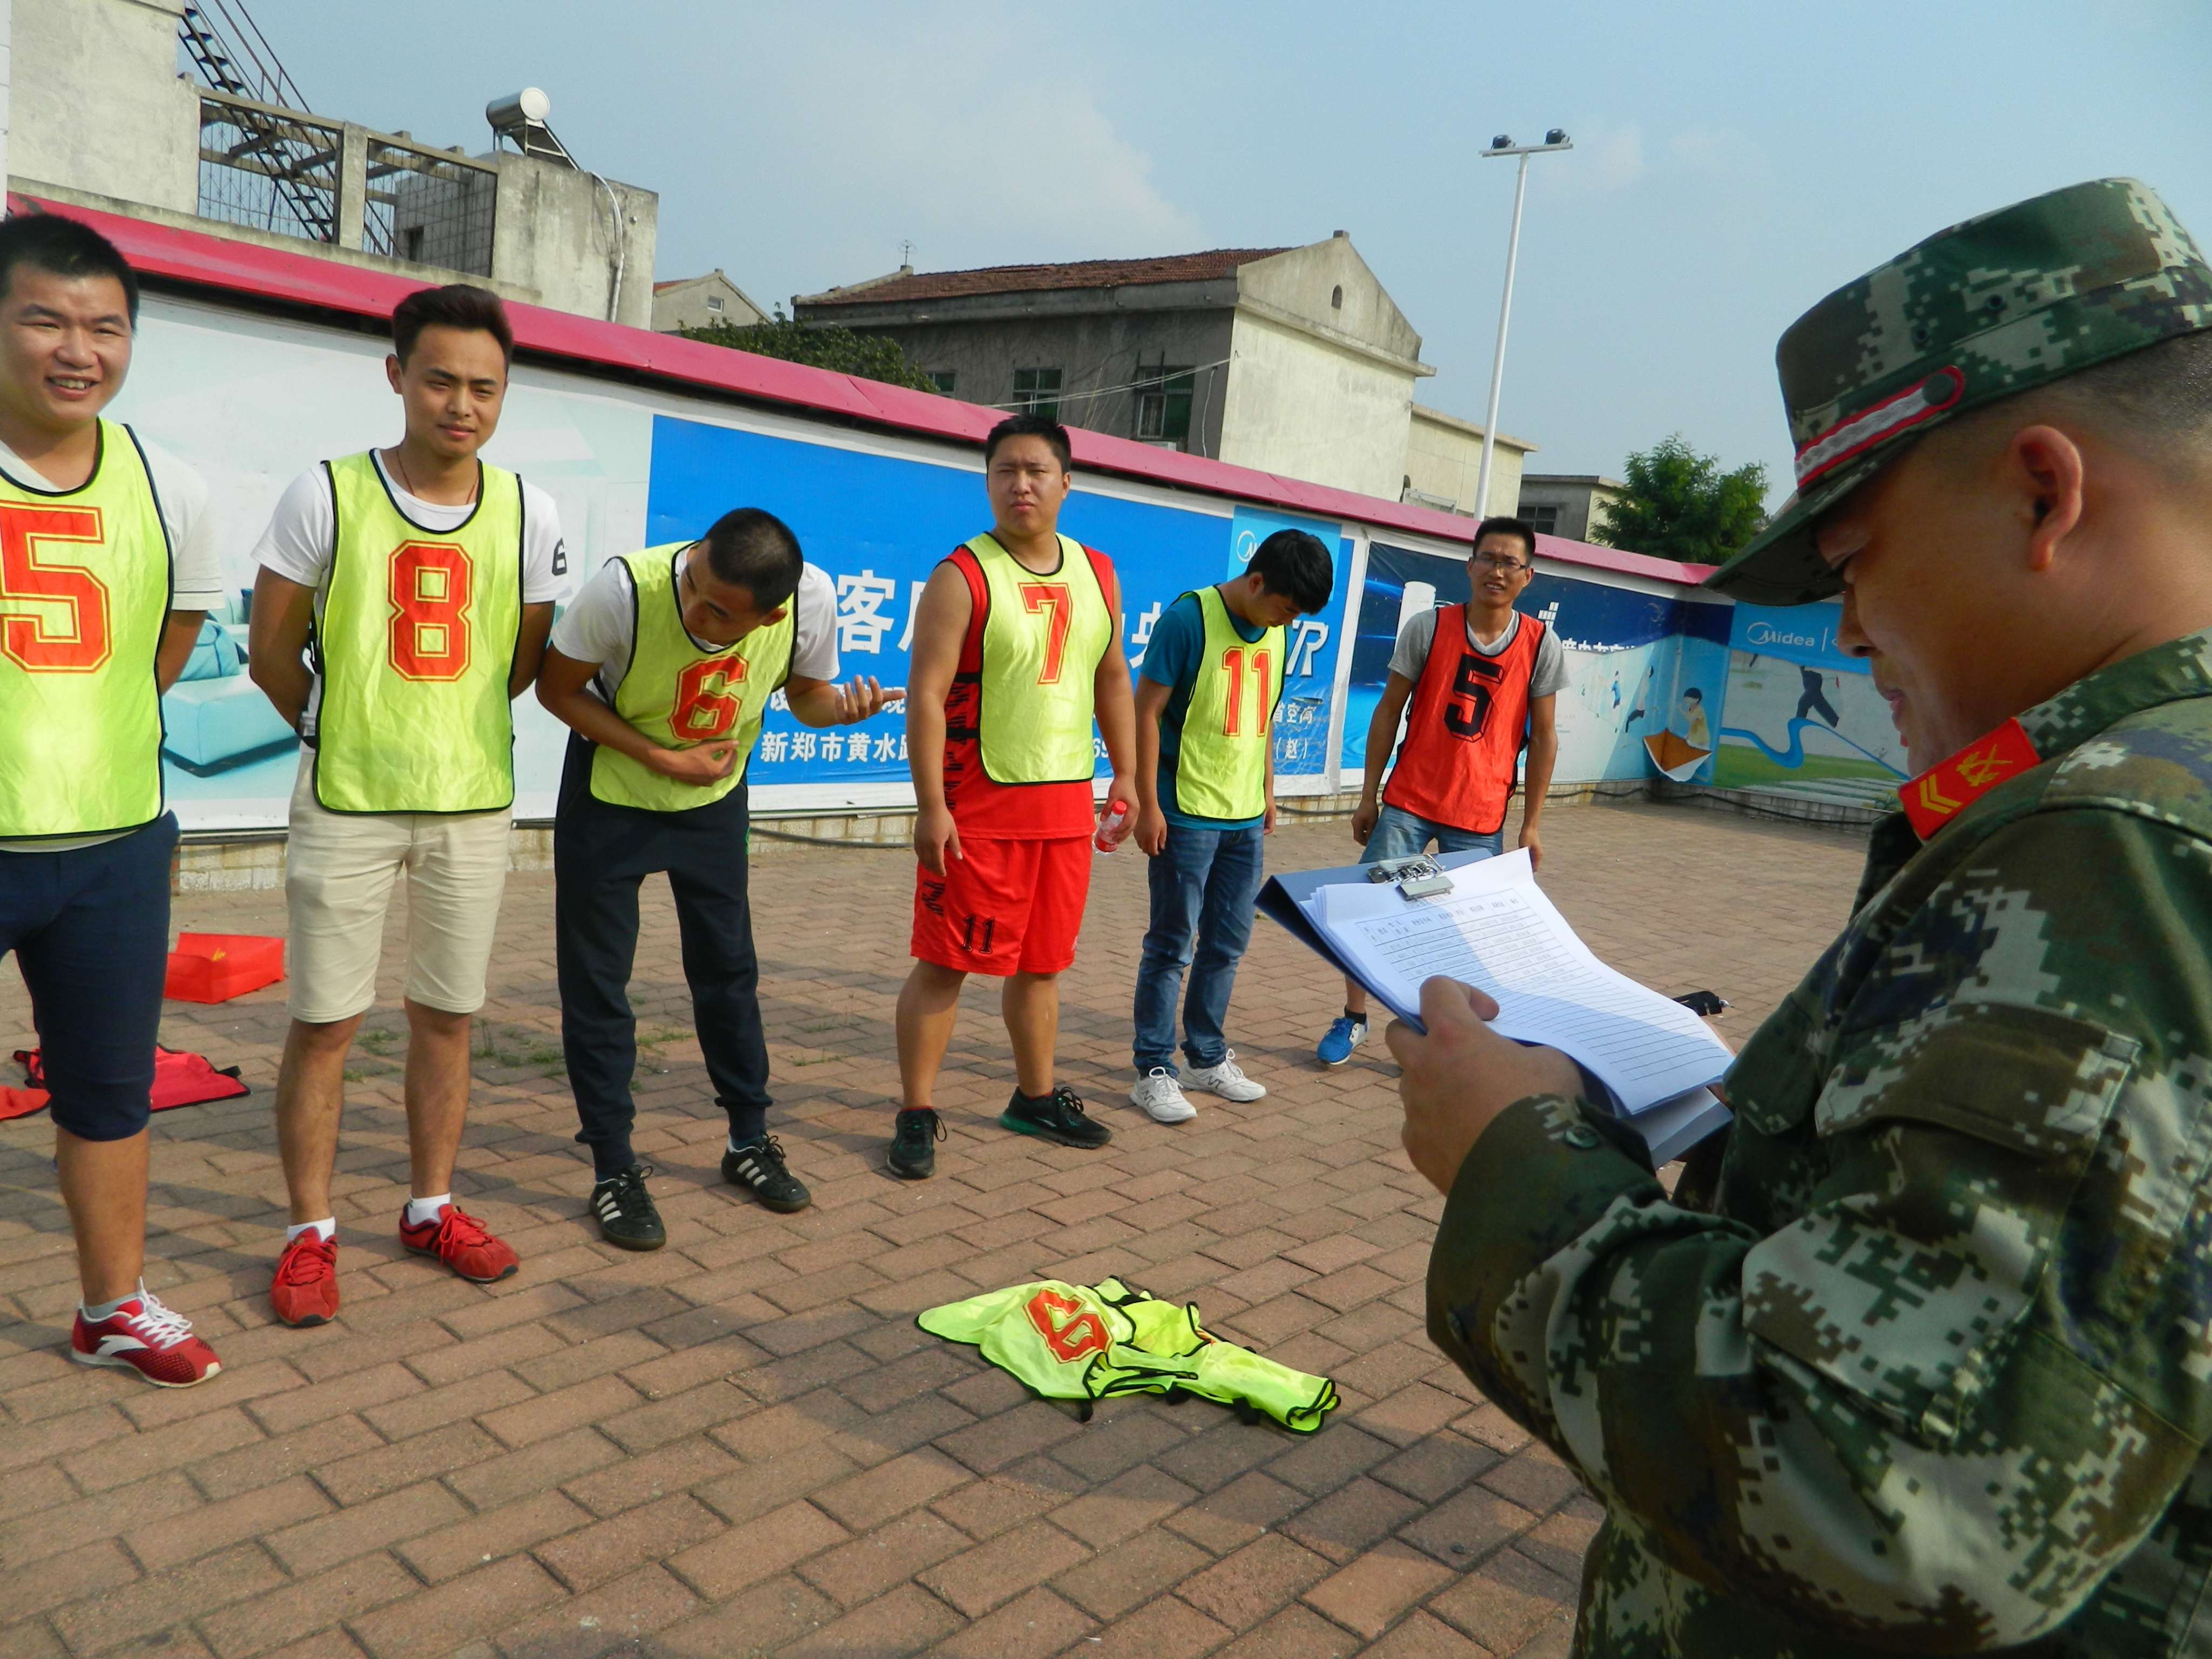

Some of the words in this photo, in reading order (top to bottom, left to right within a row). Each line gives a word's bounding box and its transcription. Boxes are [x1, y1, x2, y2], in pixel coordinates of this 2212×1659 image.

[0, 500, 112, 673] 5
[388, 539, 474, 682] 8
[1018, 582, 1074, 685] 7
[1748, 623, 1815, 647] Midea
[667, 651, 750, 743] 6
[1222, 646, 1271, 737] 11
[1444, 652, 1505, 743] 5
[962, 913, 996, 954] 11
